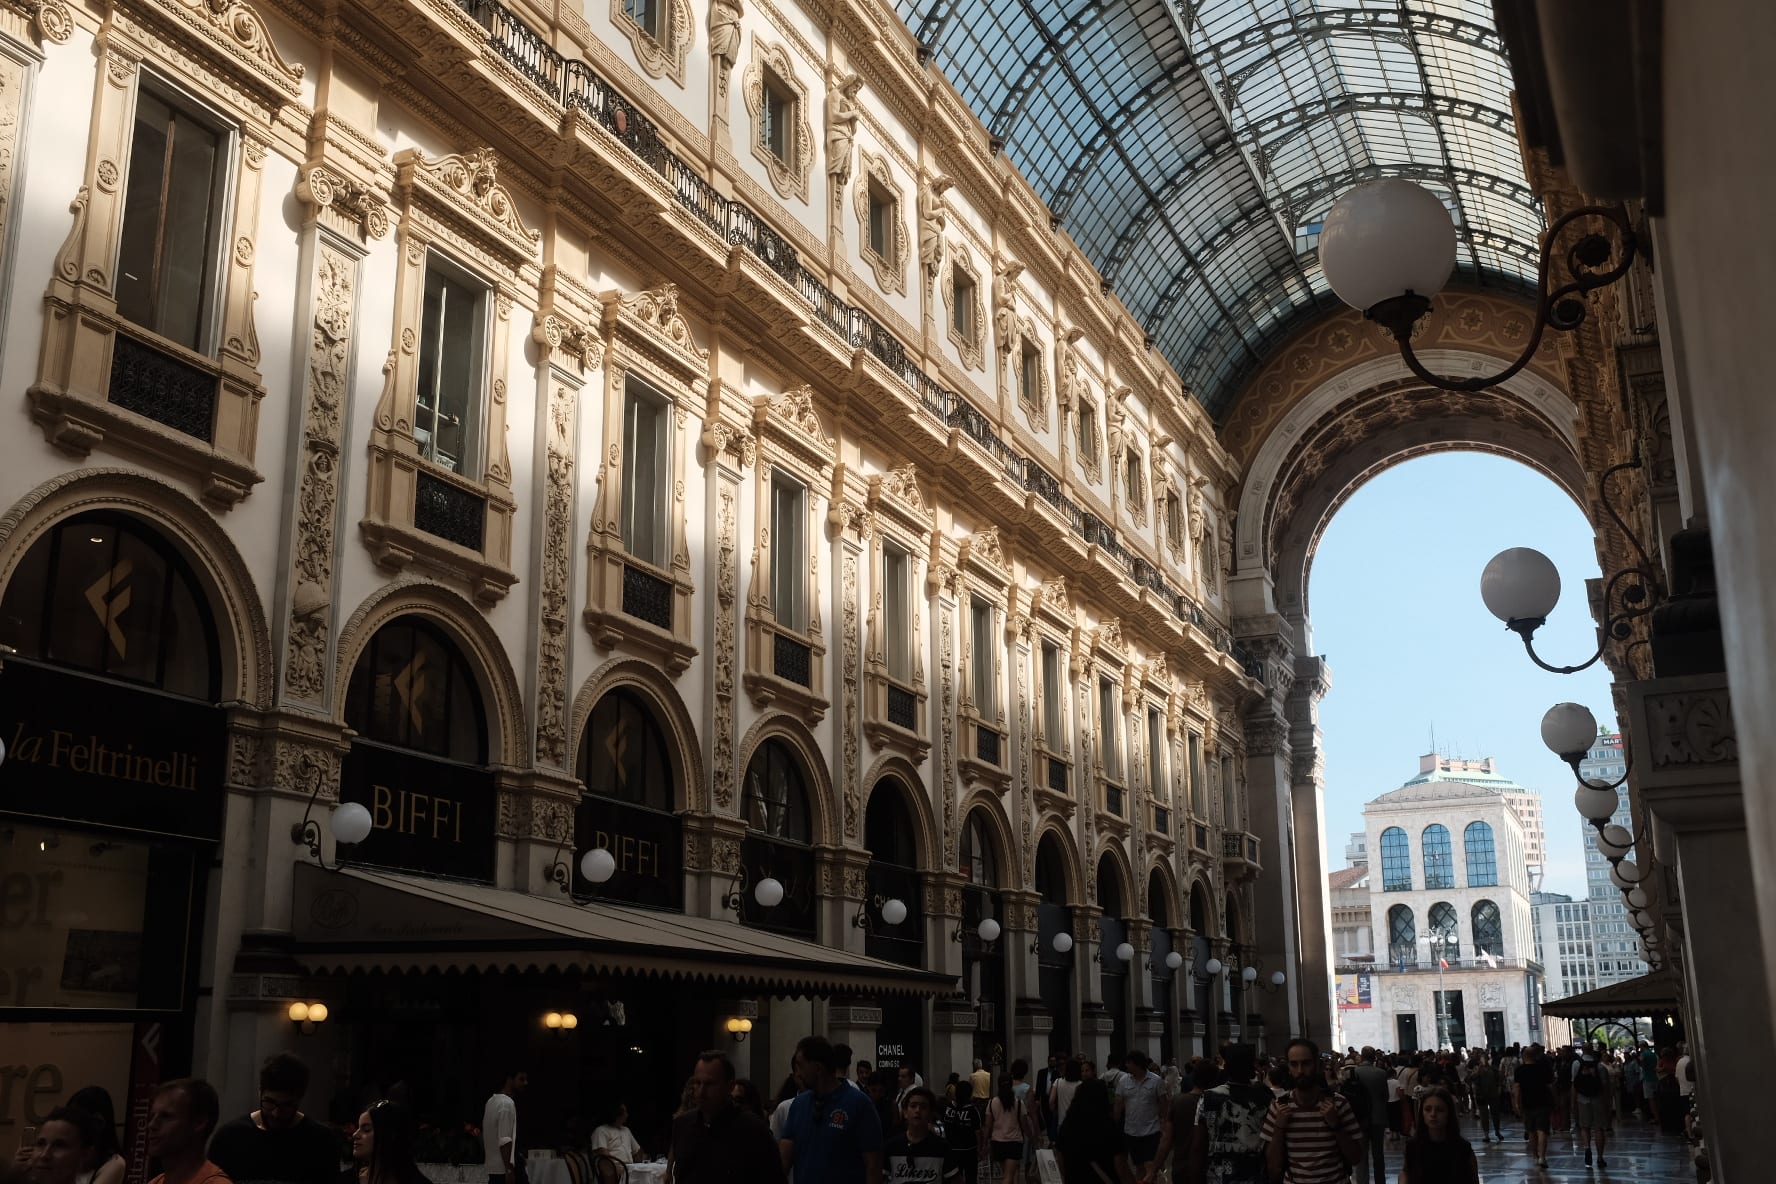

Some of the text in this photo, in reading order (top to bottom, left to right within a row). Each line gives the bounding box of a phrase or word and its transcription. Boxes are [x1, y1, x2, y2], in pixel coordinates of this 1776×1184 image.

[7, 720, 200, 791] la Feltrinelli
[372, 784, 464, 843] BIFFI
[879, 1044, 905, 1056] CHANEL
